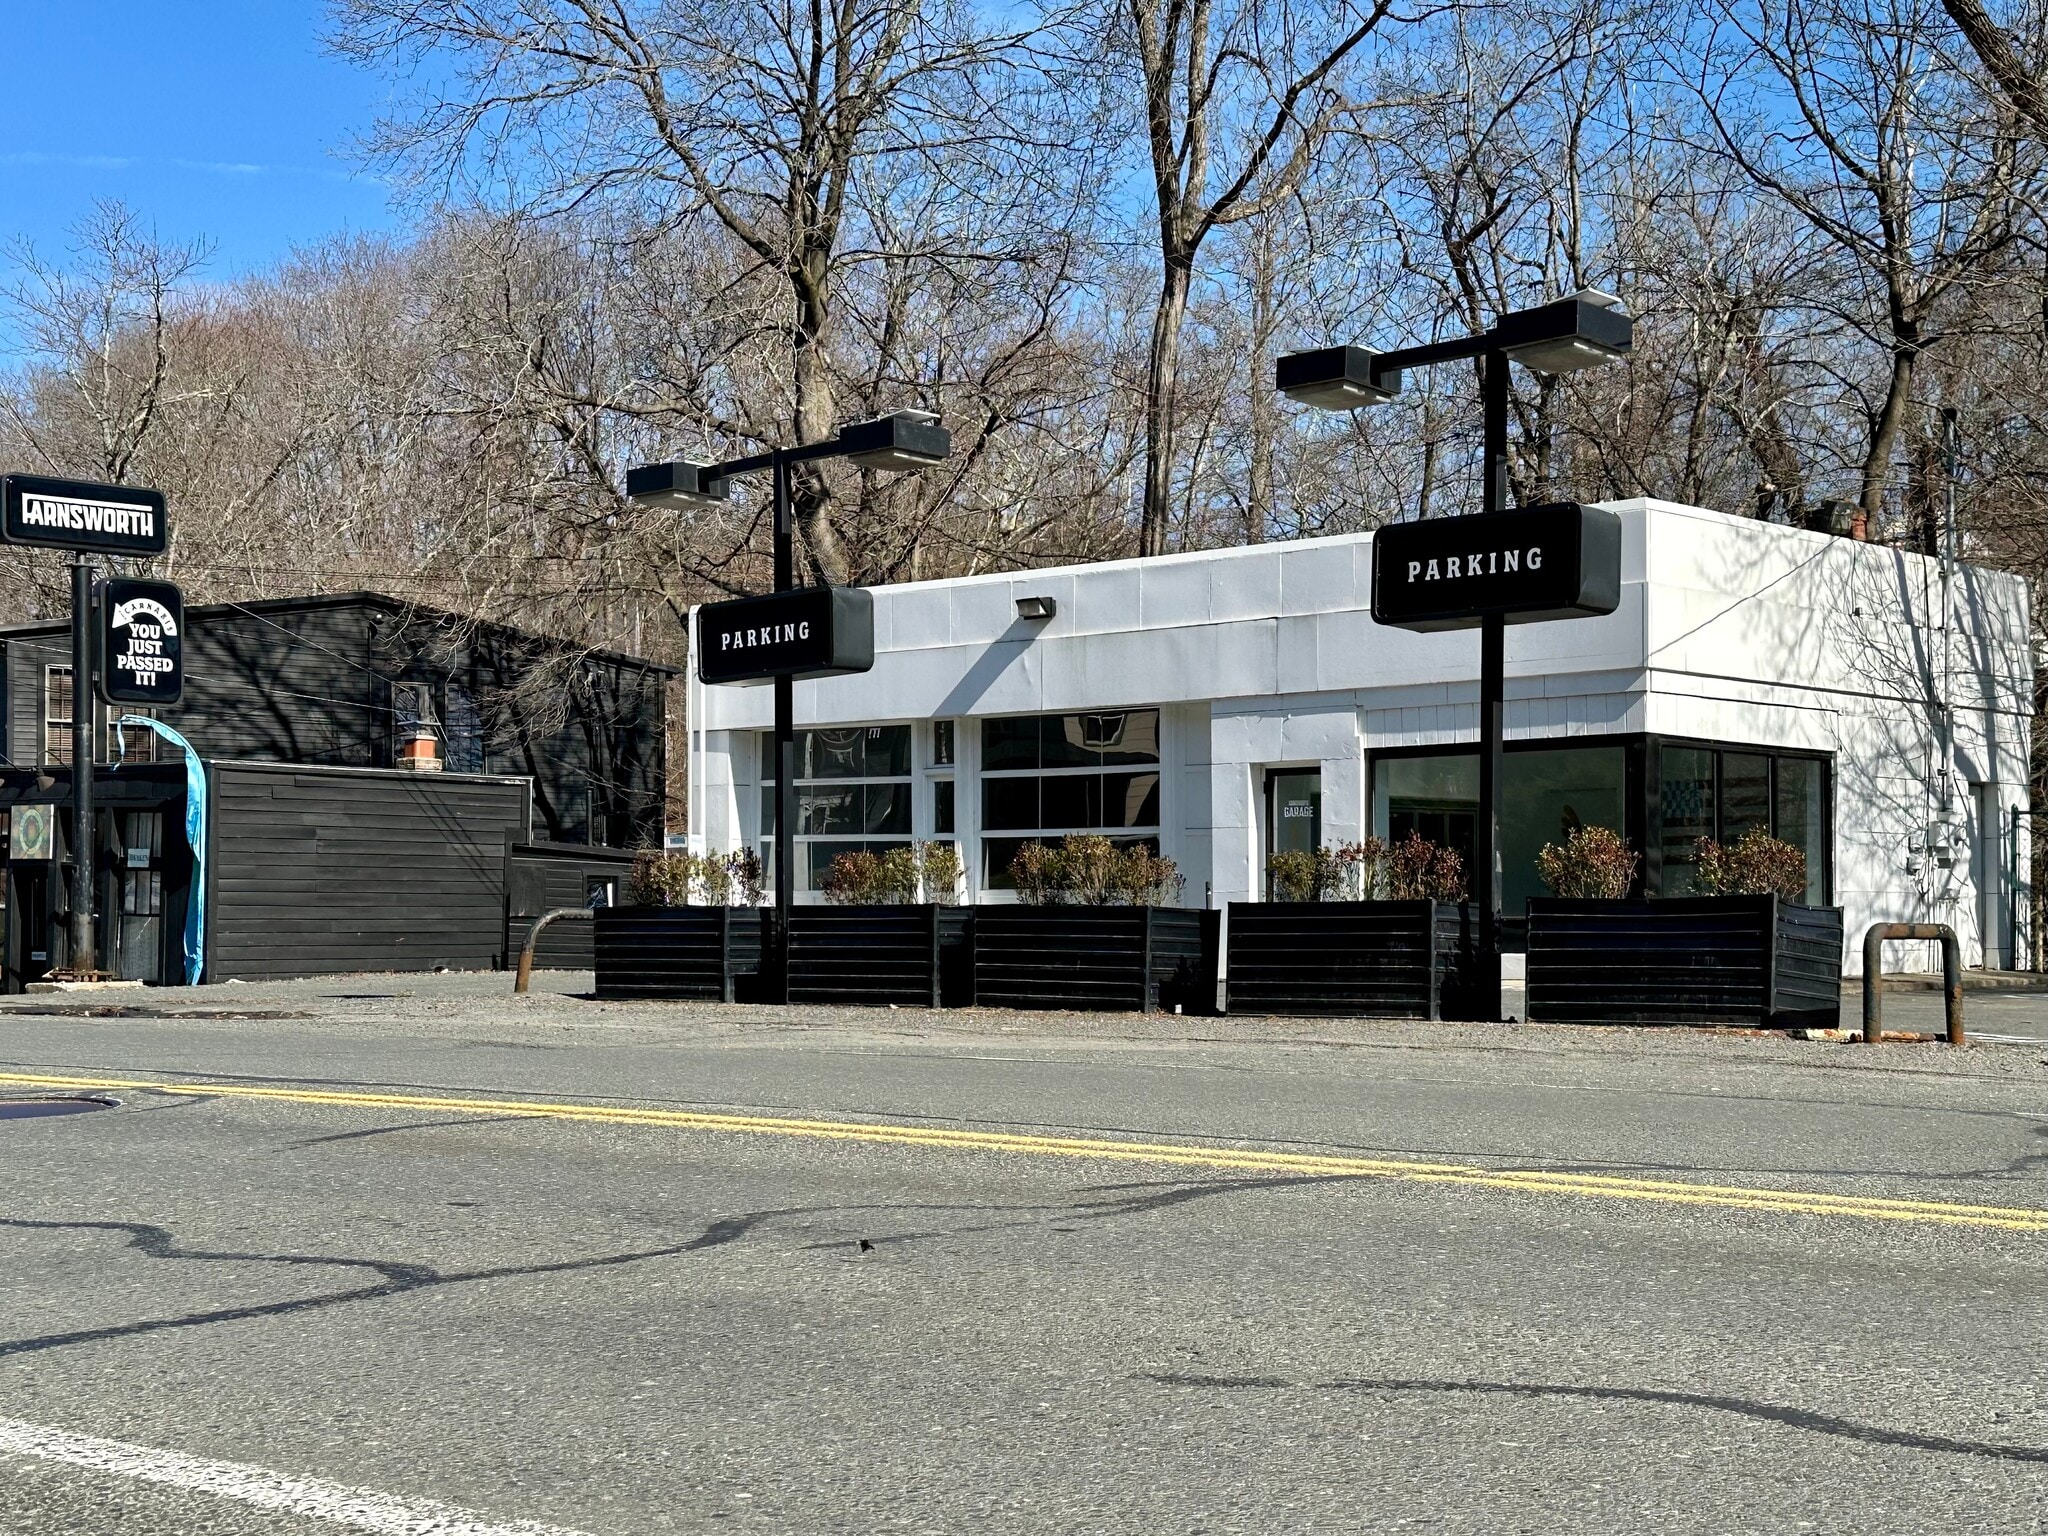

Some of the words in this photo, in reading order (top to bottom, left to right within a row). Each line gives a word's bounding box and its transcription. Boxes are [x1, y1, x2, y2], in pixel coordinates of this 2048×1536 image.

[22, 493, 153, 536] FARNSWORTH
[1408, 548, 1541, 582] PARKING
[129, 623, 160, 639] YOU
[722, 622, 809, 650] PARKING
[126, 638, 163, 656] JUST
[116, 654, 174, 672] PASSED
[135, 671, 156, 686] IT!
[1284, 806, 1313, 817] GARAGE
